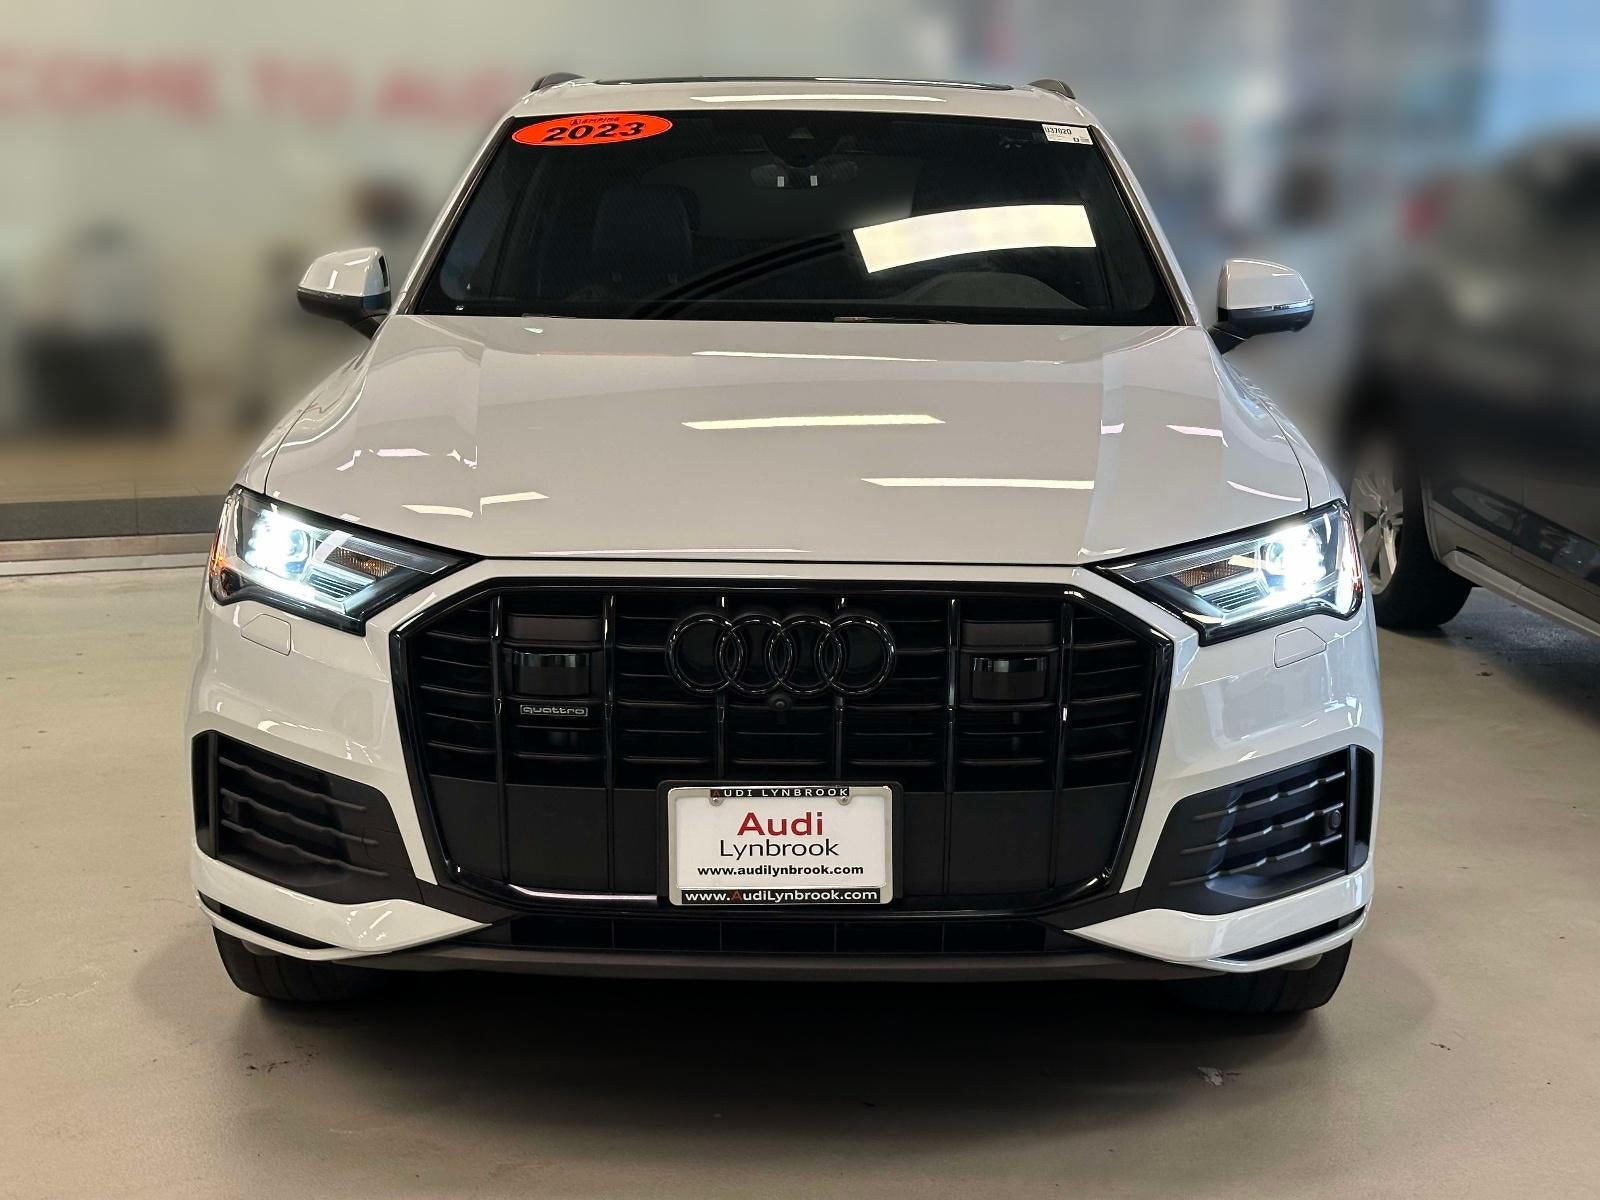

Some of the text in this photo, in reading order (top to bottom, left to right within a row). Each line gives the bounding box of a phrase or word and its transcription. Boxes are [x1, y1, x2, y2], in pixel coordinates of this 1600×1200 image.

[542, 121, 646, 142] 2023
[523, 706, 585, 715] quattro
[711, 787, 849, 798] AUDI LYNBROOK
[737, 811, 823, 836] Audi
[720, 838, 840, 860] Lynbrook
[697, 864, 864, 877] www.audilynbrook.com
[685, 888, 878, 903] www.AudiLynbrook.com
